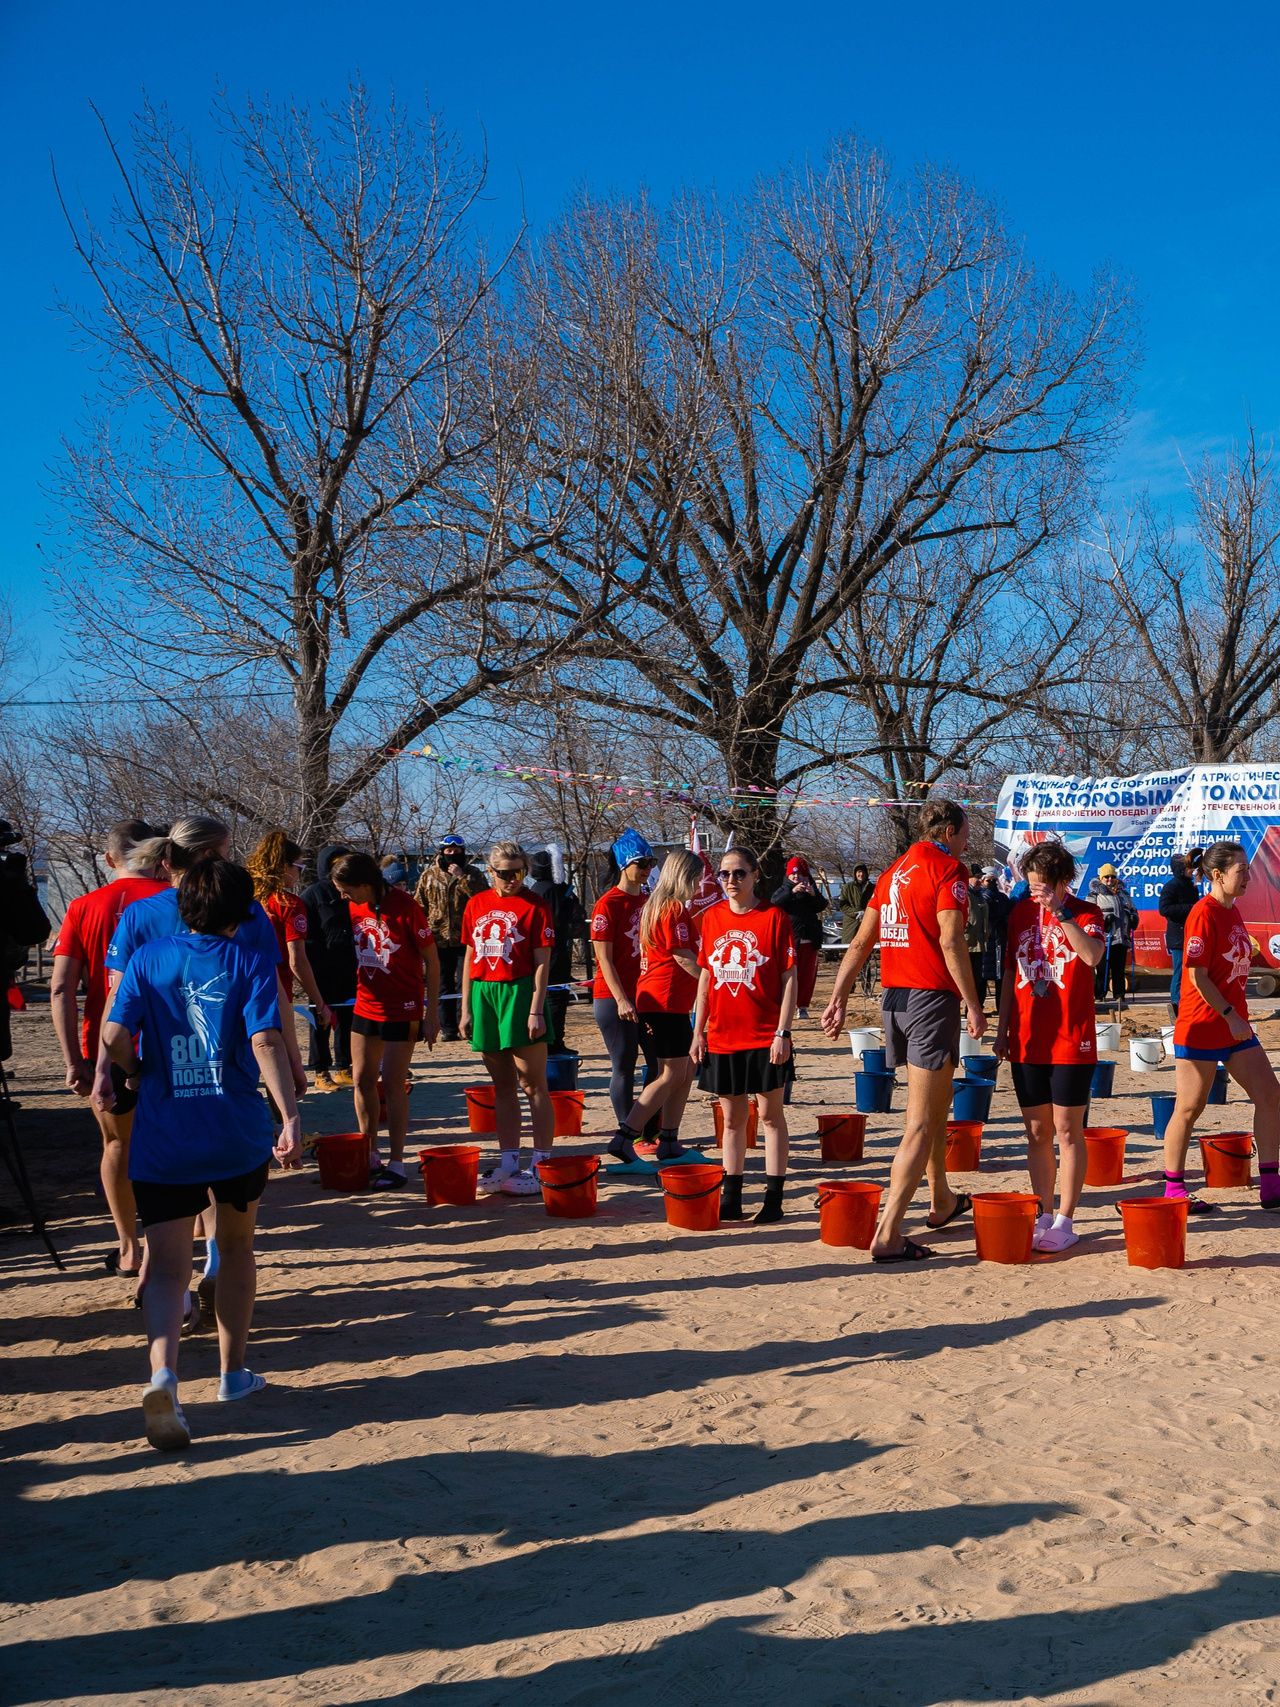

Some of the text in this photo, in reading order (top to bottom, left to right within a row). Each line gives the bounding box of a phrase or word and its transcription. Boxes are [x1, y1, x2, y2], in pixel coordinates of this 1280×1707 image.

[1055, 788, 1173, 808] ЗДОРОВЫМ
[1108, 808, 1149, 817] ПОБЕДЫ
[1130, 886, 1140, 897] г.
[880, 903, 897, 924] 80
[170, 1034, 207, 1064] 80
[174, 1088, 199, 1098] БУДЕТ
